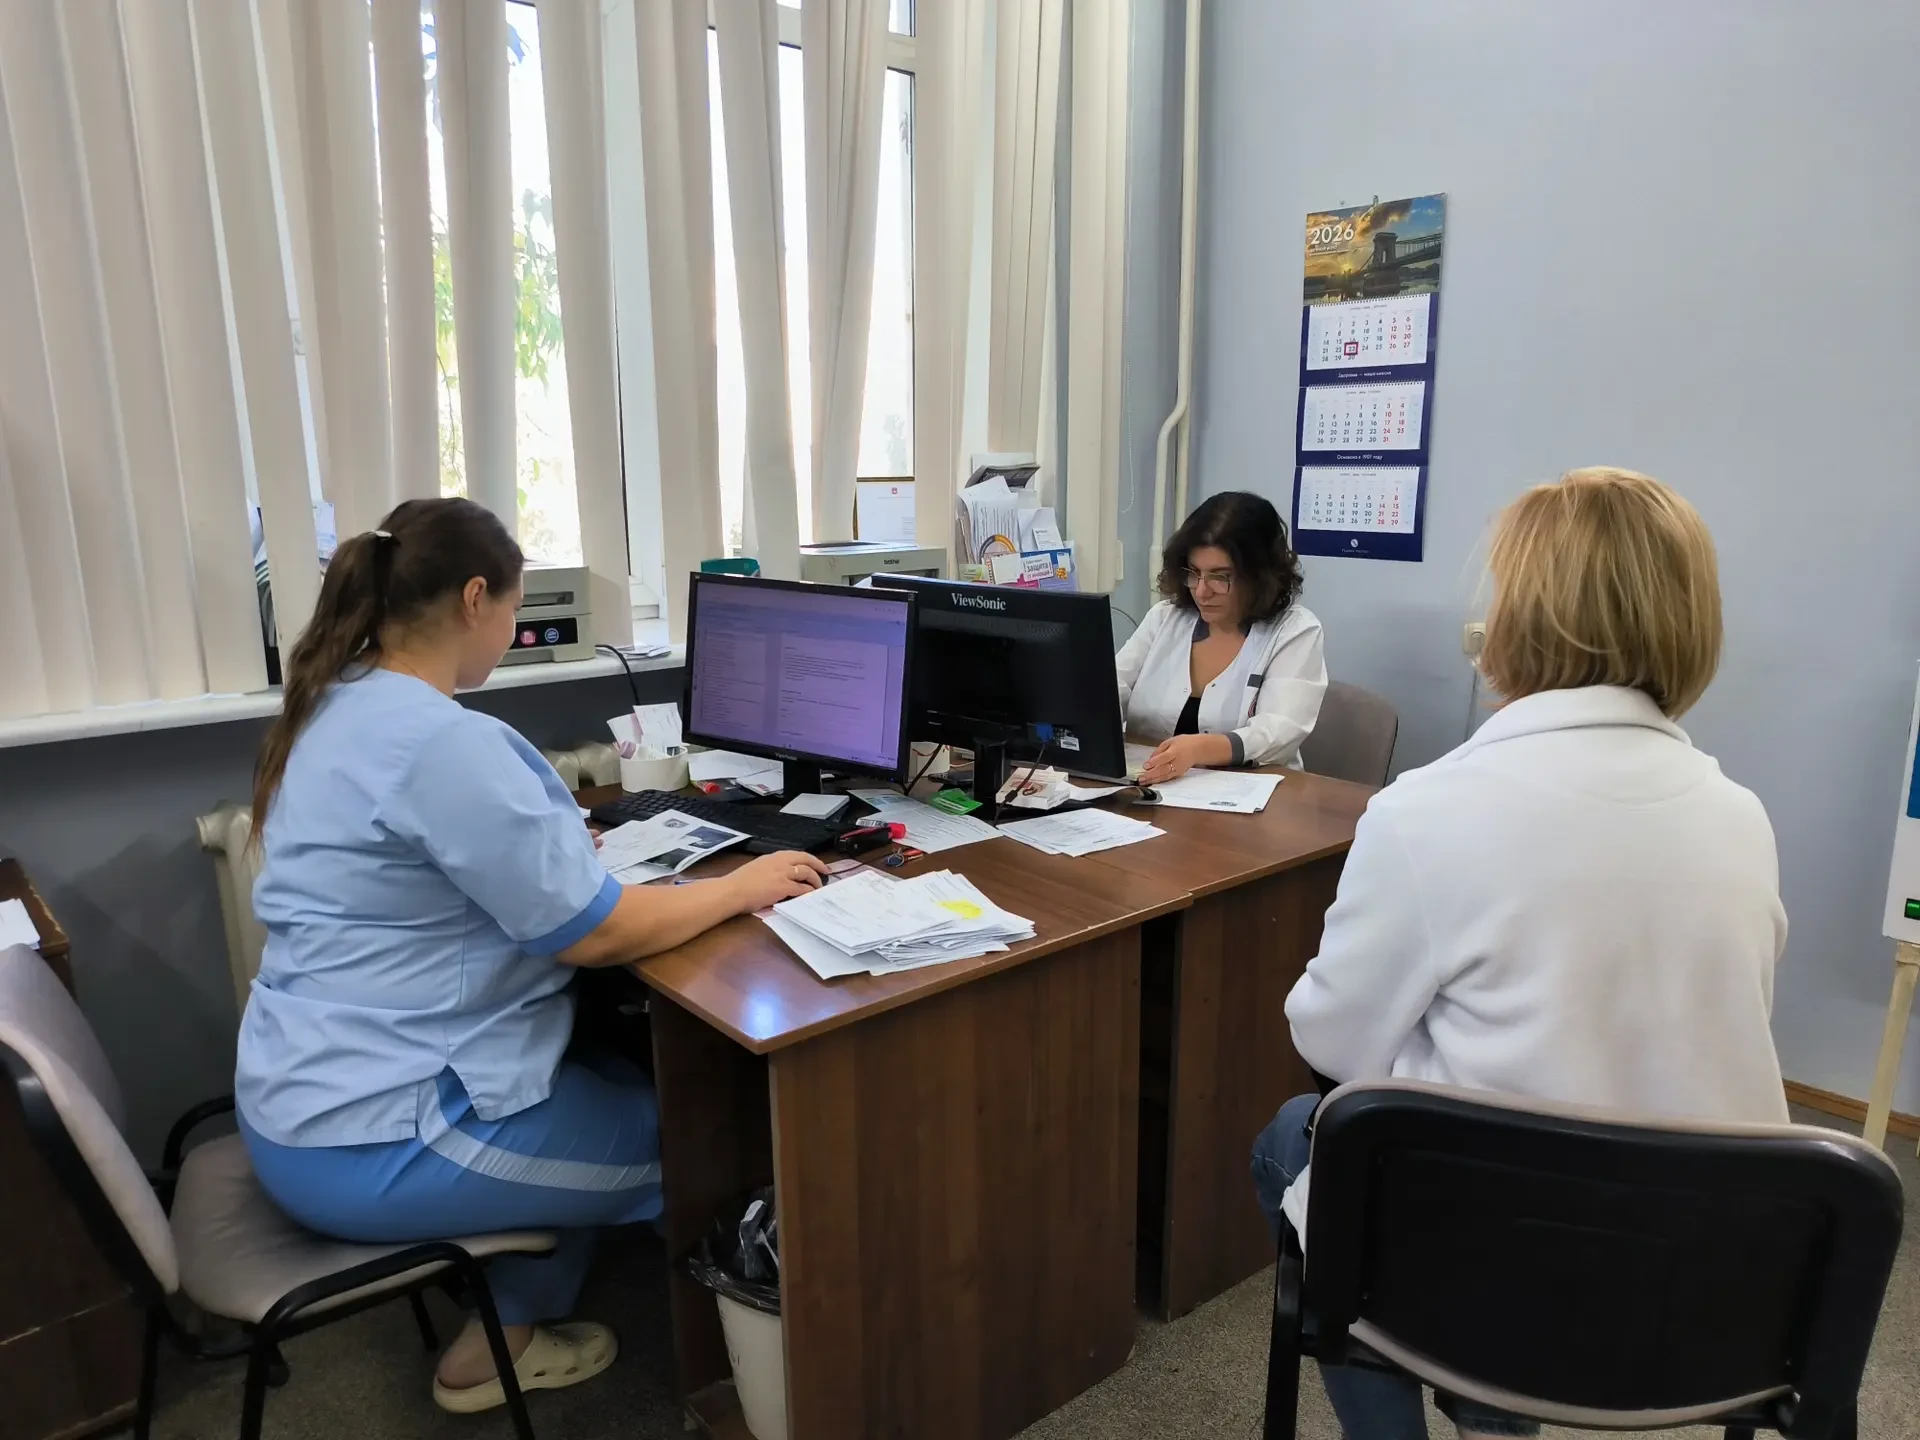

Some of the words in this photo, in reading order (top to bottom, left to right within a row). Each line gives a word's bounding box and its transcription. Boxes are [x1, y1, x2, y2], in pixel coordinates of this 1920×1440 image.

[1310, 223, 1354, 244] 2026
[1027, 562, 1048, 573] защита
[951, 592, 1006, 610] ViewSonic
